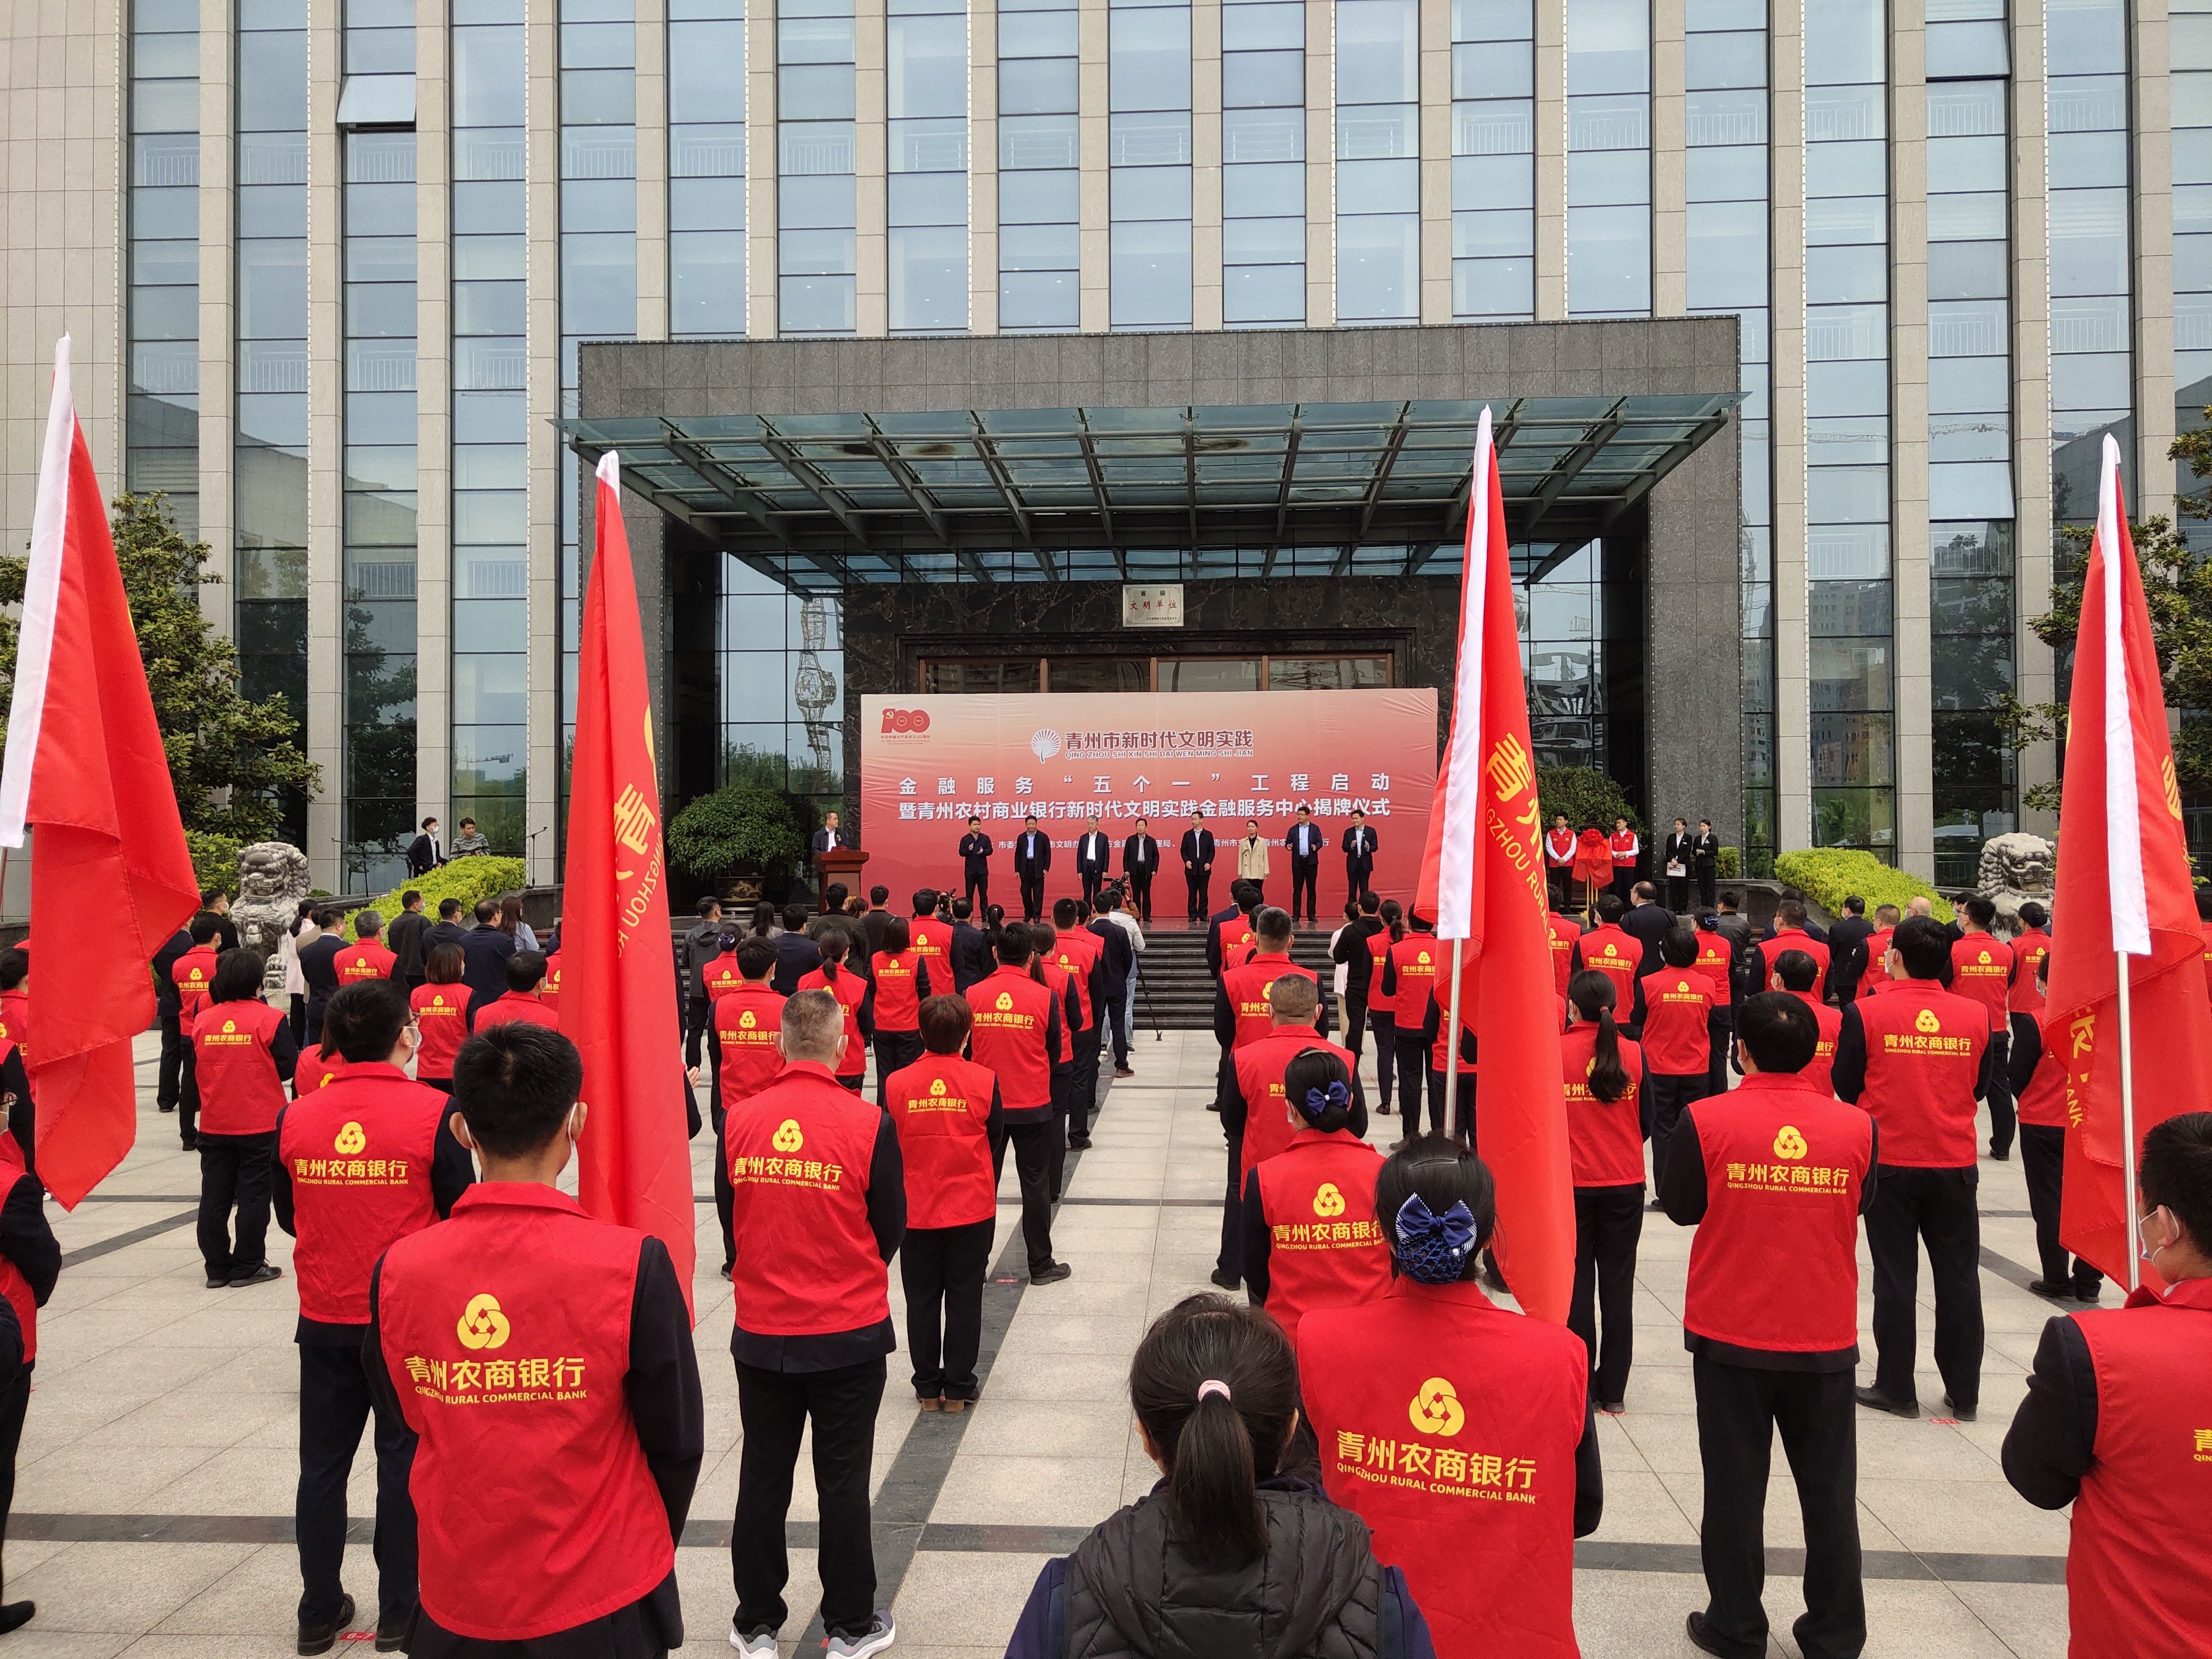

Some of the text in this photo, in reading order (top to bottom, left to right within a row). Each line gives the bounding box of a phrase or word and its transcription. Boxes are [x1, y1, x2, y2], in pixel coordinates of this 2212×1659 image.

[1130, 599, 1177, 611] 文明单位
[1065, 730, 1252, 749] 青州市新时代文明实践
[898, 798, 1391, 821] 暨青州农村商业银行新时代文明实践金融服务中心揭牌仪式
[1588, 957, 1633, 968] 青州农商银行
[1663, 993, 1703, 1001] 青州农商银行
[973, 1012, 1035, 1025] 青州农商银行
[205, 1034, 253, 1042] 青州农商银行
[1883, 1034, 1972, 1051] 青州农商银行
[908, 1098, 967, 1109] 青州农商银行
[294, 1159, 409, 1178] 青州农商银行
[734, 1156, 843, 1183] 青州农商银行
[1726, 1163, 1849, 1187] 青州农商银行
[781, 1179, 822, 1188] COMMERCIAL
[1727, 1182, 1764, 1190] QINGZHOU
[1331, 1240, 1373, 1249] COMMERCIAL
[404, 1355, 586, 1391] 青州农商银行
[415, 1385, 588, 1404] QINGZHOU RURAL COMMERCIAL BANK
[1336, 1430, 1537, 1489] 青州农商银行
[1336, 1462, 1537, 1505] QINGZHOU RURAL COMMERCIAL BANK
